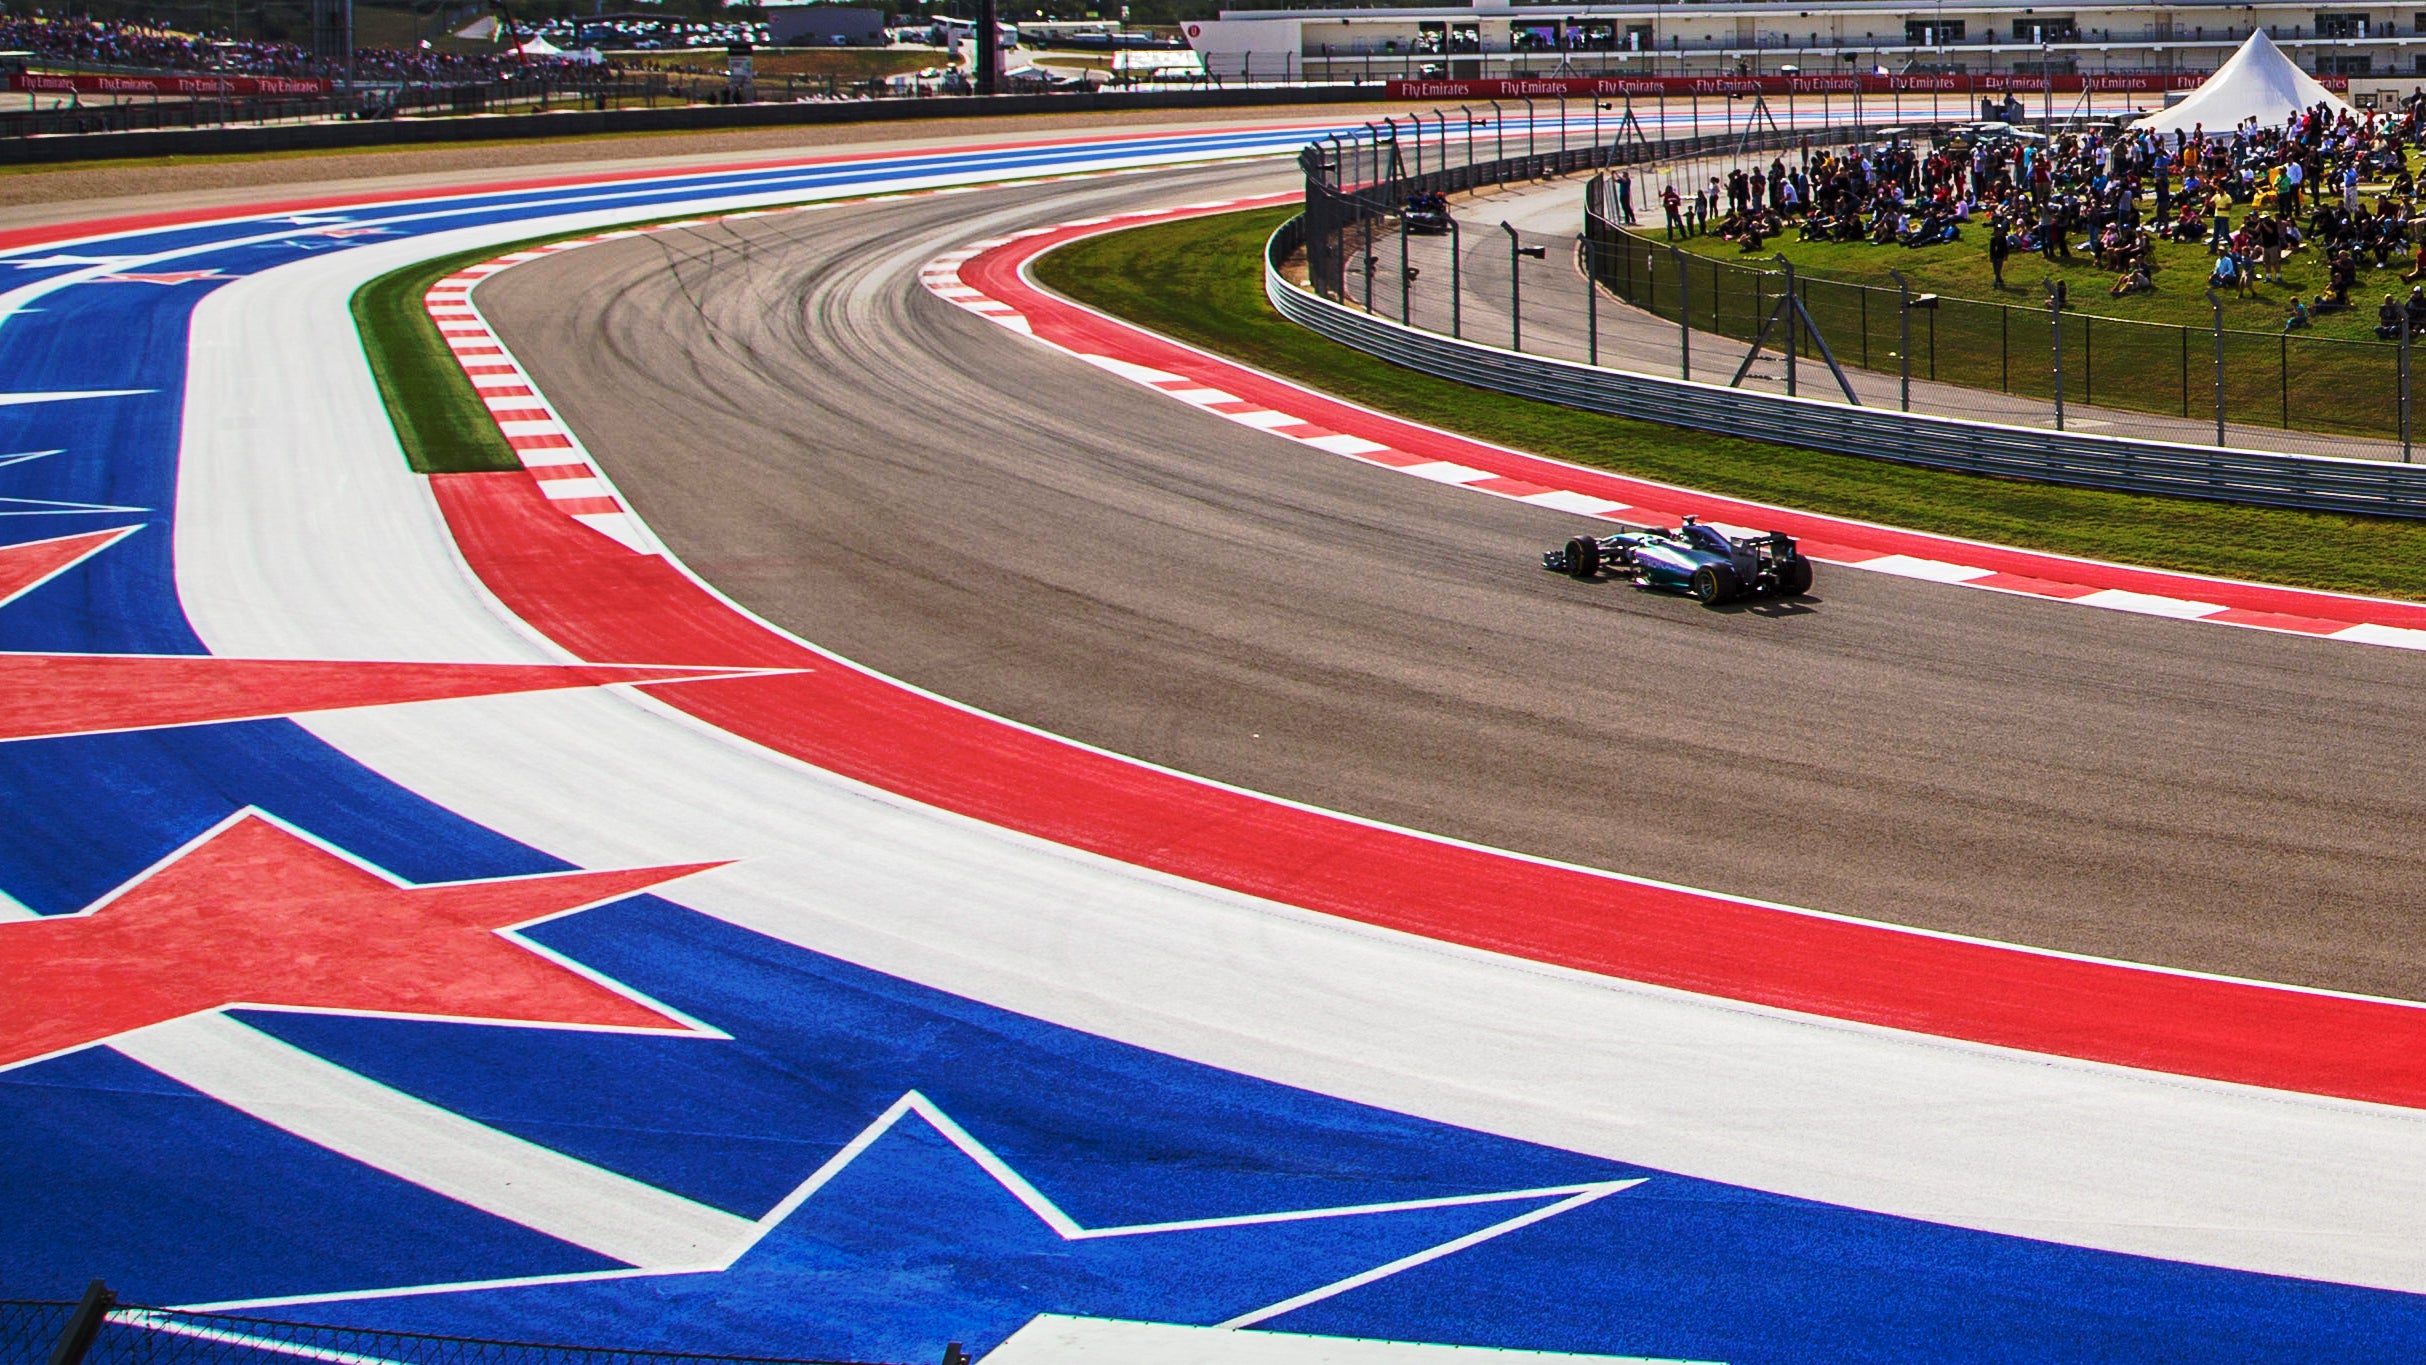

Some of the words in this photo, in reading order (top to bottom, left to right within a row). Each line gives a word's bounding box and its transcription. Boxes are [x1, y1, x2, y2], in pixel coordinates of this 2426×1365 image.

[21, 76, 36, 89] Fly
[261, 80, 277, 93] Fly
[1501, 81, 1519, 96] Fly
[1521, 80, 1567, 94] Emirates
[1598, 80, 1616, 94] Fly
[1618, 80, 1664, 92] Emirates
[1696, 79, 1714, 93] Fly
[1793, 78, 1811, 92] Fly
[1910, 76, 1955, 89] Emirates
[2101, 76, 2147, 89] Emirates
[2177, 77, 2195, 89] Fly
[2321, 79, 2347, 89] rates
[1402, 83, 1420, 98] Fly
[1422, 82, 1469, 96] Emirates
